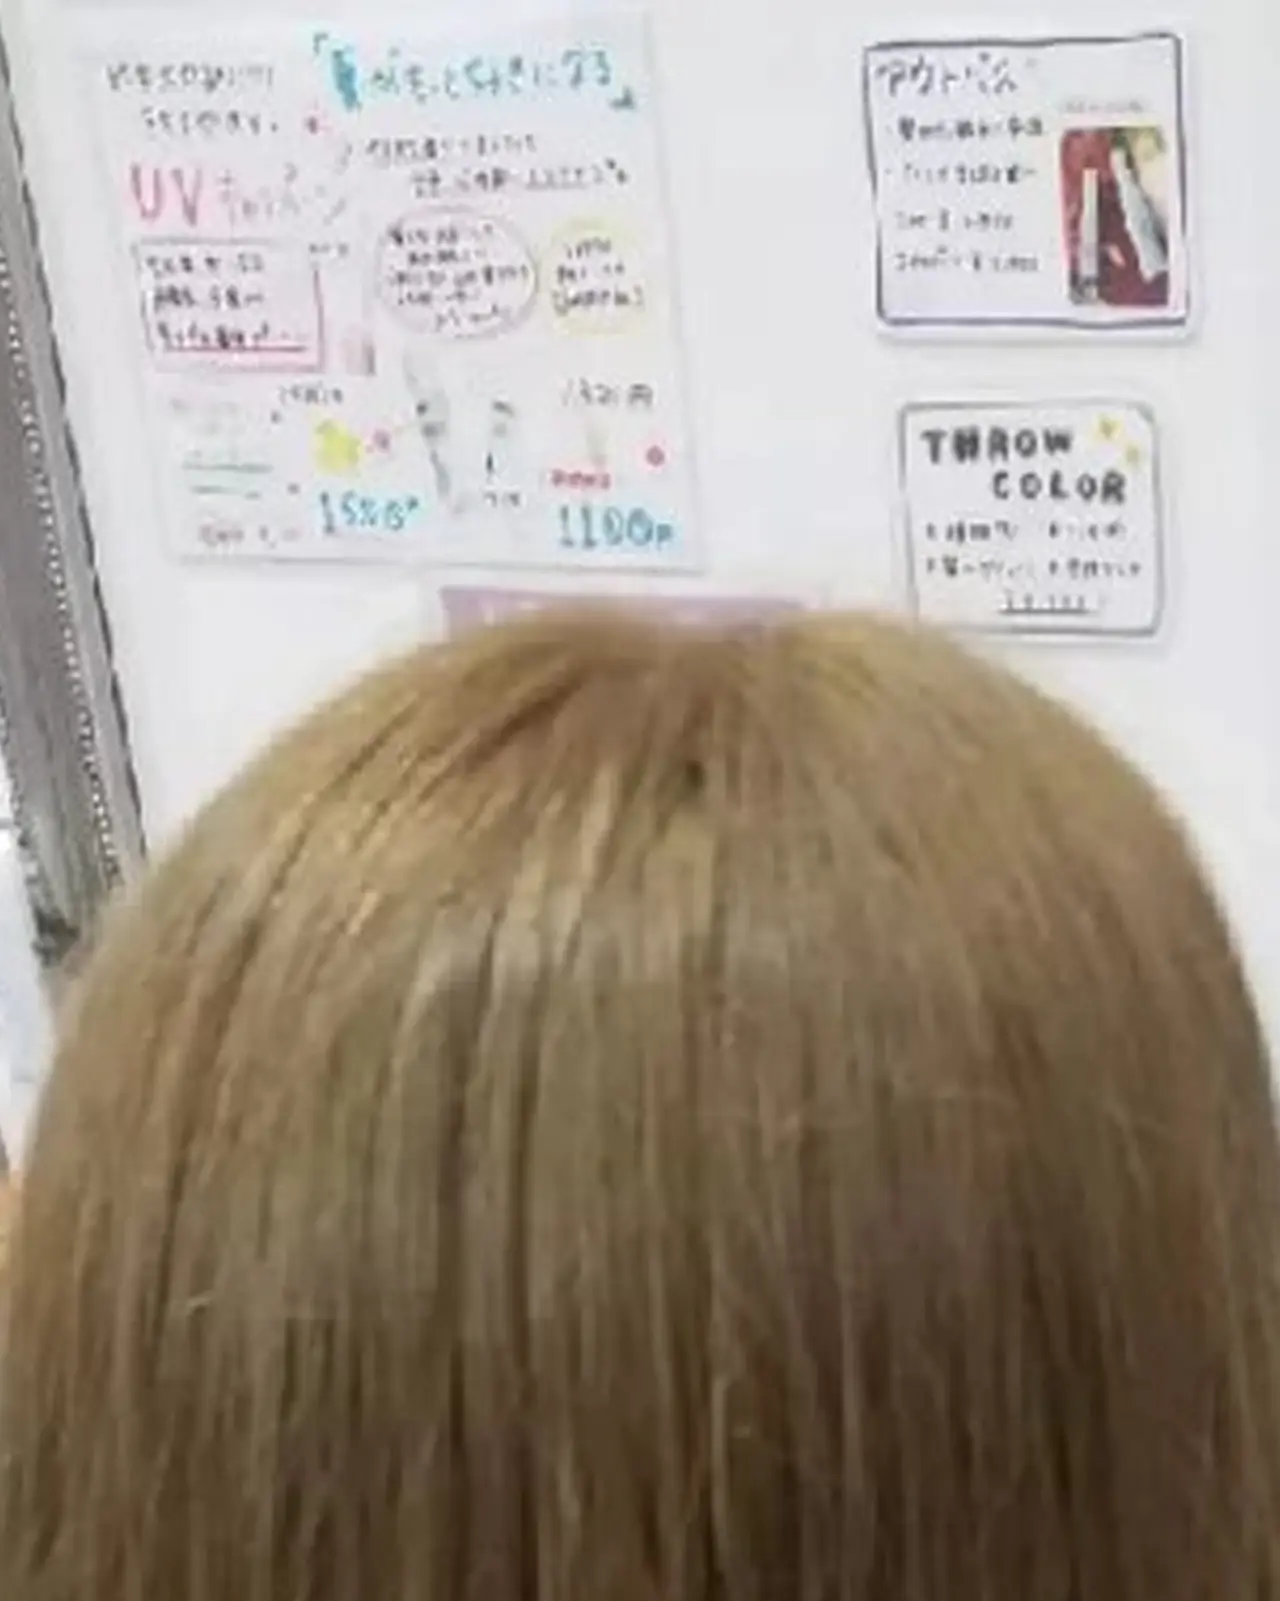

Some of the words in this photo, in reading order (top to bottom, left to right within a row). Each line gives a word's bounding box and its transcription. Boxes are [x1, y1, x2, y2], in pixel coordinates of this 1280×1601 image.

[130, 163, 202, 227] UV
[921, 426, 1074, 465] THROW
[993, 469, 1127, 505] COLOR
